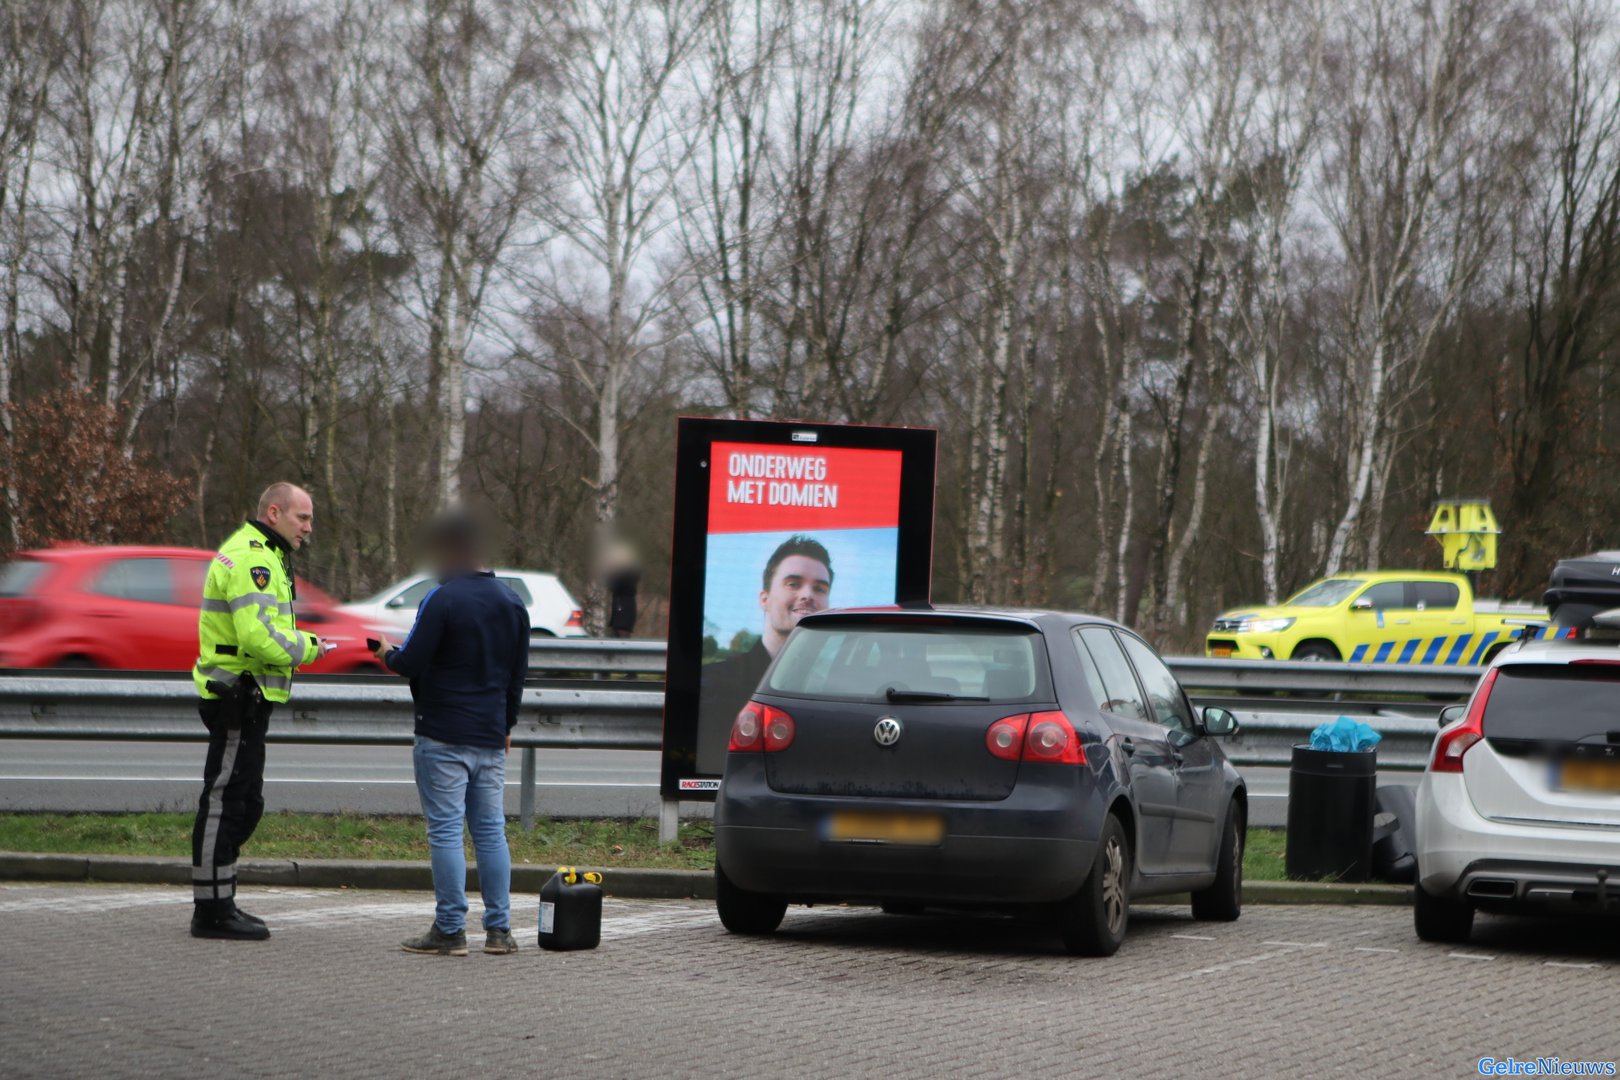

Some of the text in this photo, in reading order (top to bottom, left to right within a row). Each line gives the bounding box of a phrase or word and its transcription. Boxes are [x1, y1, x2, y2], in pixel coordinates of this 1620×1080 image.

[728, 453, 826, 480] ONDERWEG
[727, 480, 838, 508] MET DOMIEN
